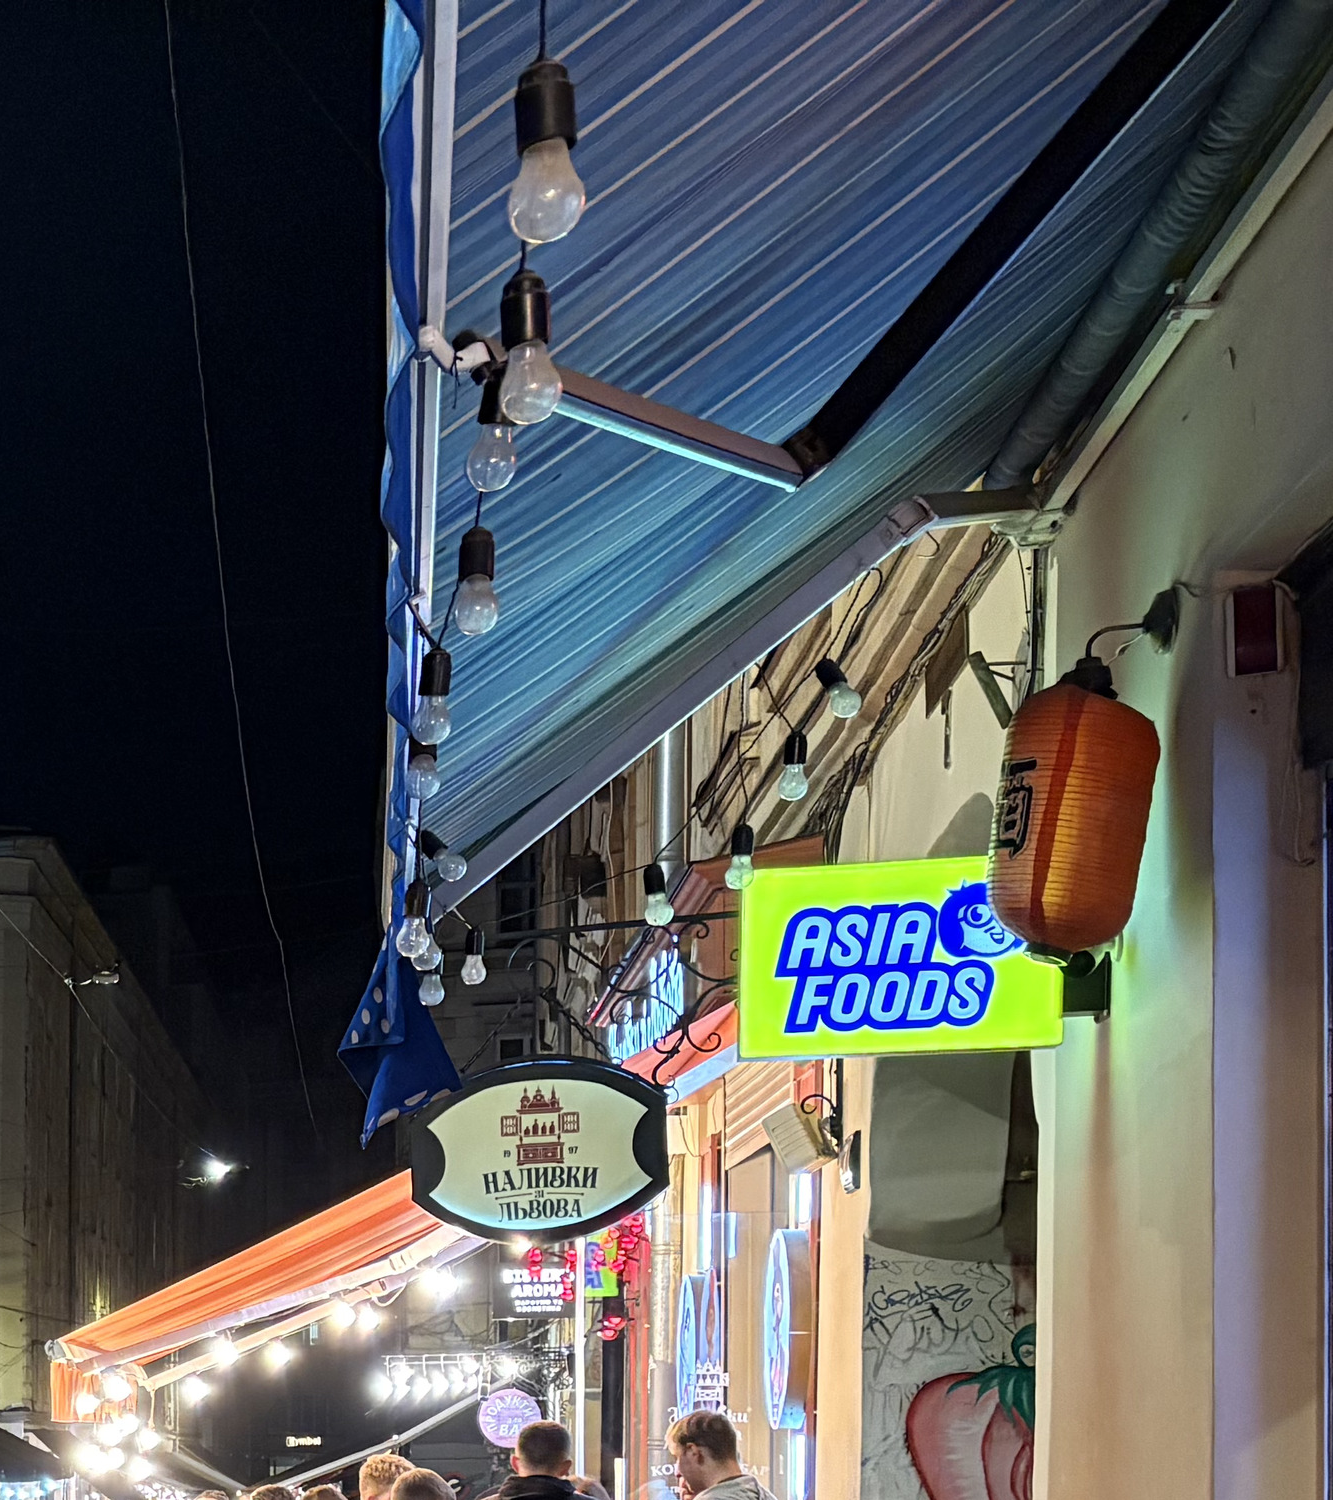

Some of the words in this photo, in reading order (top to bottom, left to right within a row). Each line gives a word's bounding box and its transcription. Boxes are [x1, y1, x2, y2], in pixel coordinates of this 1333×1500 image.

[785, 909, 933, 969] ASIA
[794, 966, 987, 1025] FOODS
[503, 1150, 511, 1158] 19
[568, 1146, 578, 1155] 97
[482, 1165, 599, 1195] НАЛИВКИ
[498, 1199, 583, 1222] ЛЬВОВА
[486, 1394, 534, 1433] ПРОДУКТИ
[500, 1424, 520, 1436] ВА
